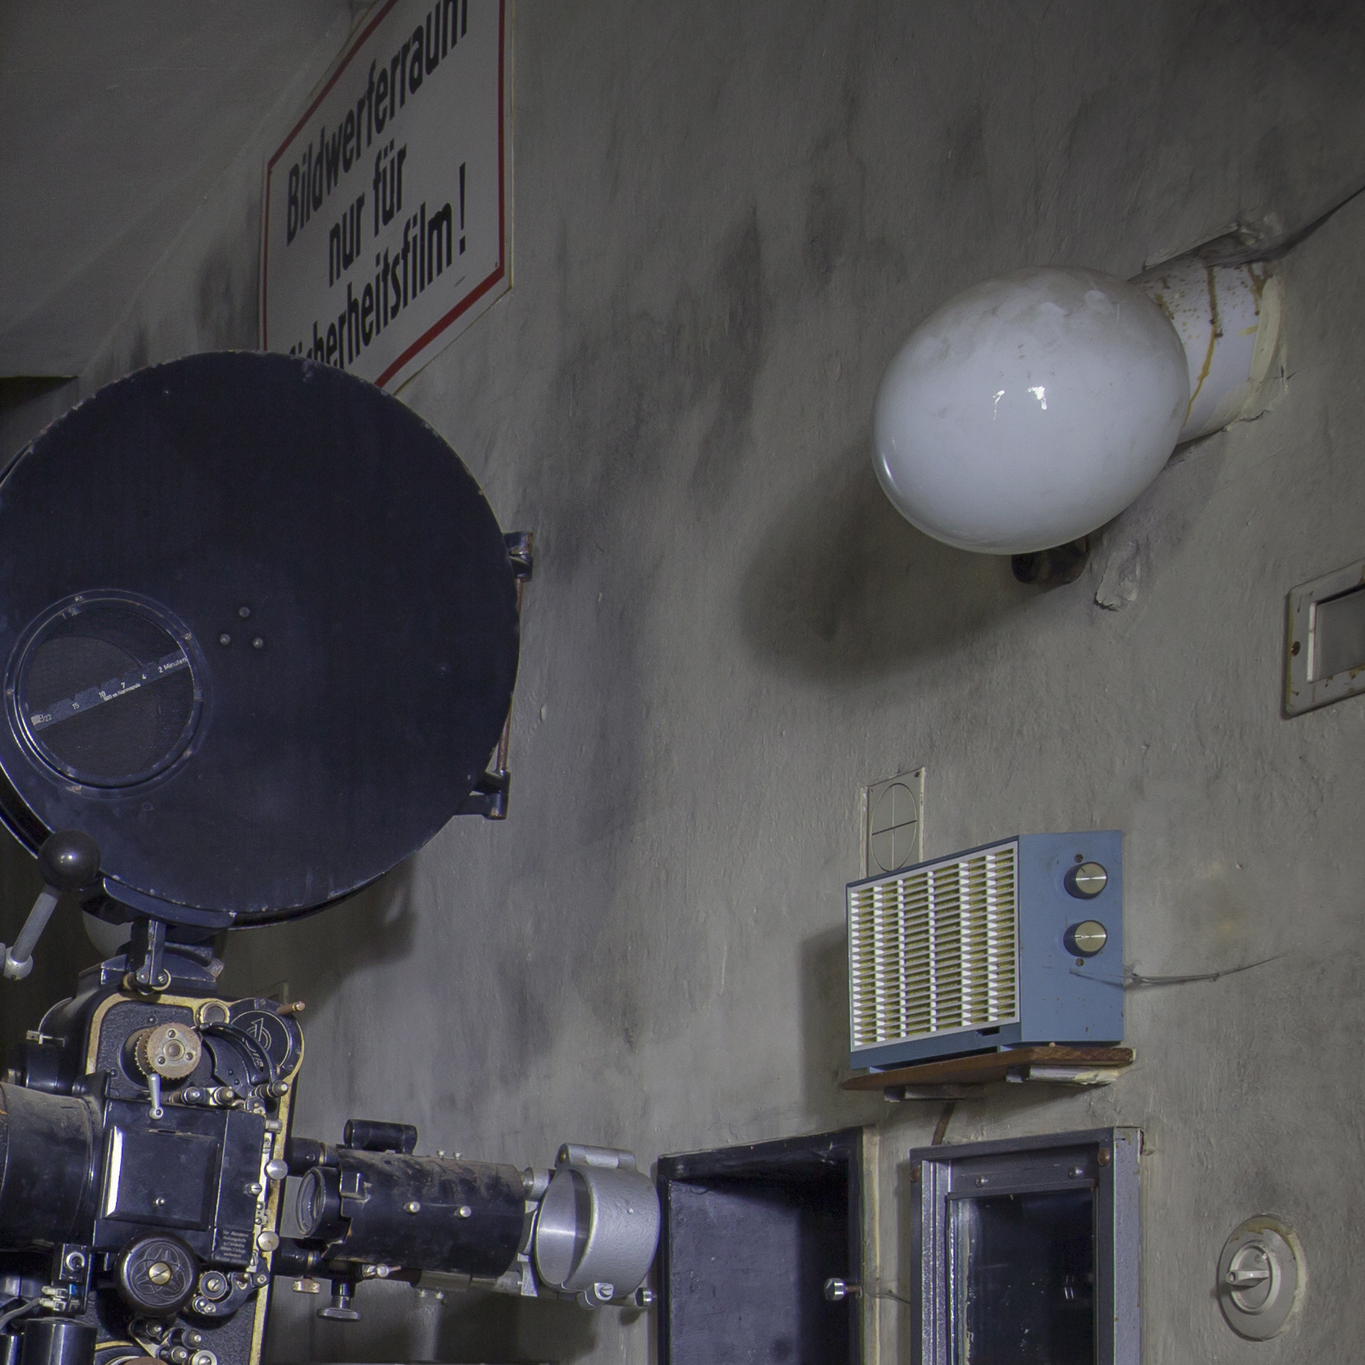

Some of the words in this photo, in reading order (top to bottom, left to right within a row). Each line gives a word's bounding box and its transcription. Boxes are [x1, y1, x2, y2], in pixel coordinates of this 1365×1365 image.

[286, 0, 467, 247] Bildwerferraum
[329, 192, 365, 288] nur
[373, 138, 408, 238] für
